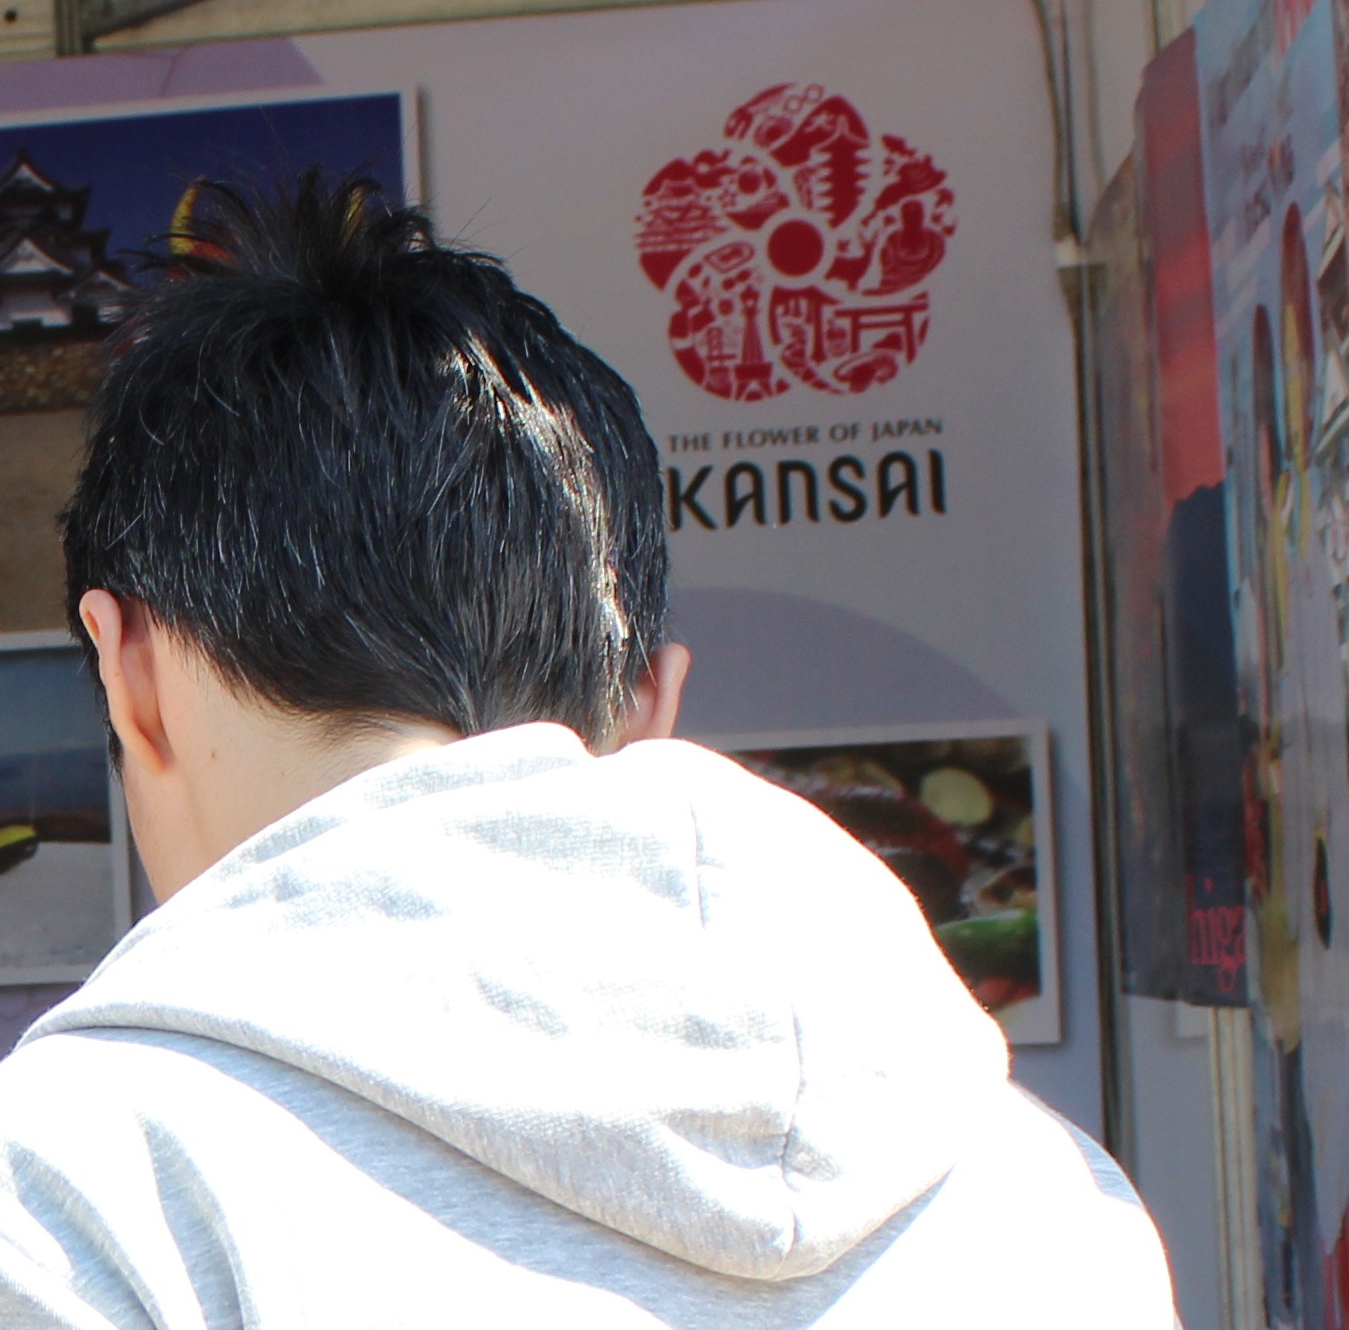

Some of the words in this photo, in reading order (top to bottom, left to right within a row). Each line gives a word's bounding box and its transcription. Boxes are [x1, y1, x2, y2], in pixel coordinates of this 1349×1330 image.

[668, 434, 712, 452] THE
[722, 425, 819, 449] FLOWER
[829, 423, 860, 442] OF
[871, 419, 943, 441] JAPAN
[667, 449, 946, 531] KANSAI
